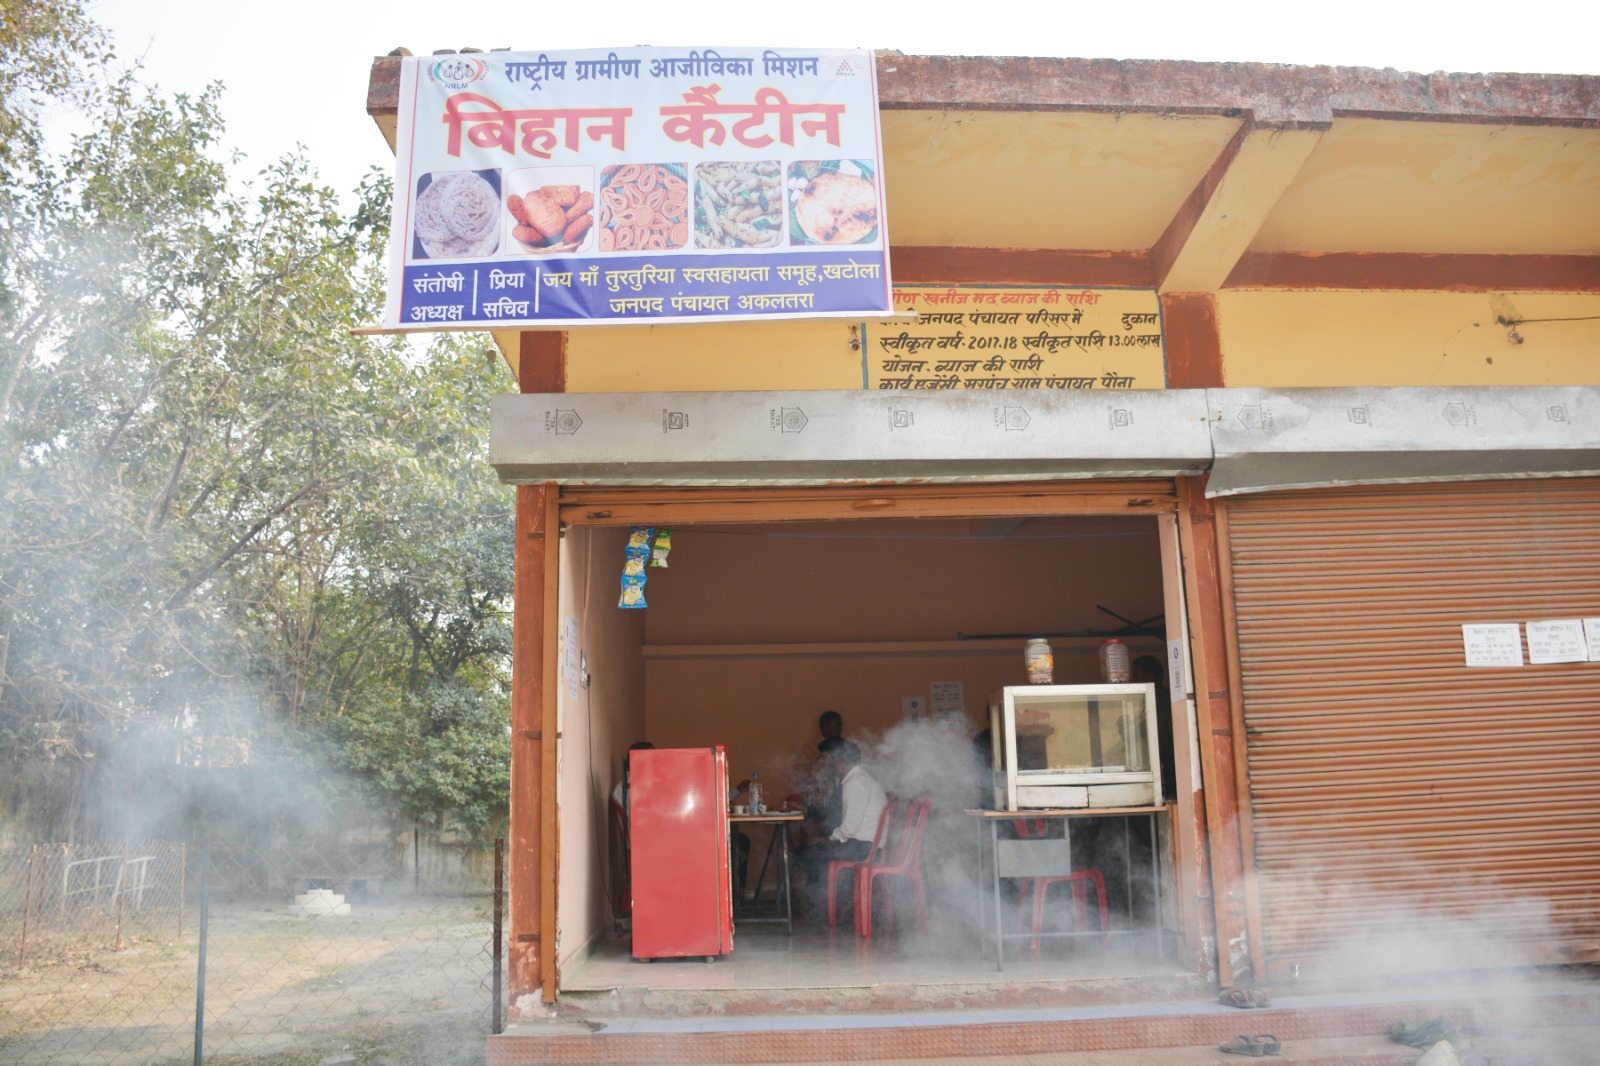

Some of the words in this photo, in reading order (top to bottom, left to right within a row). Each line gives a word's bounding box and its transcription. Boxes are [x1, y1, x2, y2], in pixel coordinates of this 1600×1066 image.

[505, 54, 567, 91] राष्ट्रीय
[575, 52, 641, 81] ग्रामीण
[650, 50, 754, 78] आजीविका
[762, 50, 819, 78] मिशन
[442, 92, 633, 160] बिहान
[413, 272, 465, 294] संतोषी
[489, 269, 526, 290] प्रिया
[543, 272, 573, 288] जय
[580, 265, 599, 286] माँ
[605, 264, 676, 293] तुरतुरिया
[682, 266, 770, 284] स्वसहायता
[483, 297, 530, 318] सचिव
[609, 297, 664, 314] जनपद
[671, 291, 730, 312] पंचायत
[737, 293, 814, 310] अकलतरा
[1041, 289, 1061, 304] की
[1065, 290, 1102, 307] राशि
[411, 304, 464, 321] अध्यक्ष
[918, 313, 966, 327] जनपद
[968, 309, 1023, 325] पंचायत
[1026, 309, 1072, 330] परिसर
[1071, 308, 1084, 324] में
[1121, 313, 1159, 330] दुकान
[880, 332, 936, 354] स्वीकृत
[1022, 331, 1074, 353] स्वीकृत
[982, 355, 1007, 372] की
[879, 373, 915, 389] कार्य
[964, 374, 1010, 389] सरपंच
[1045, 374, 1097, 389] पंचायत
